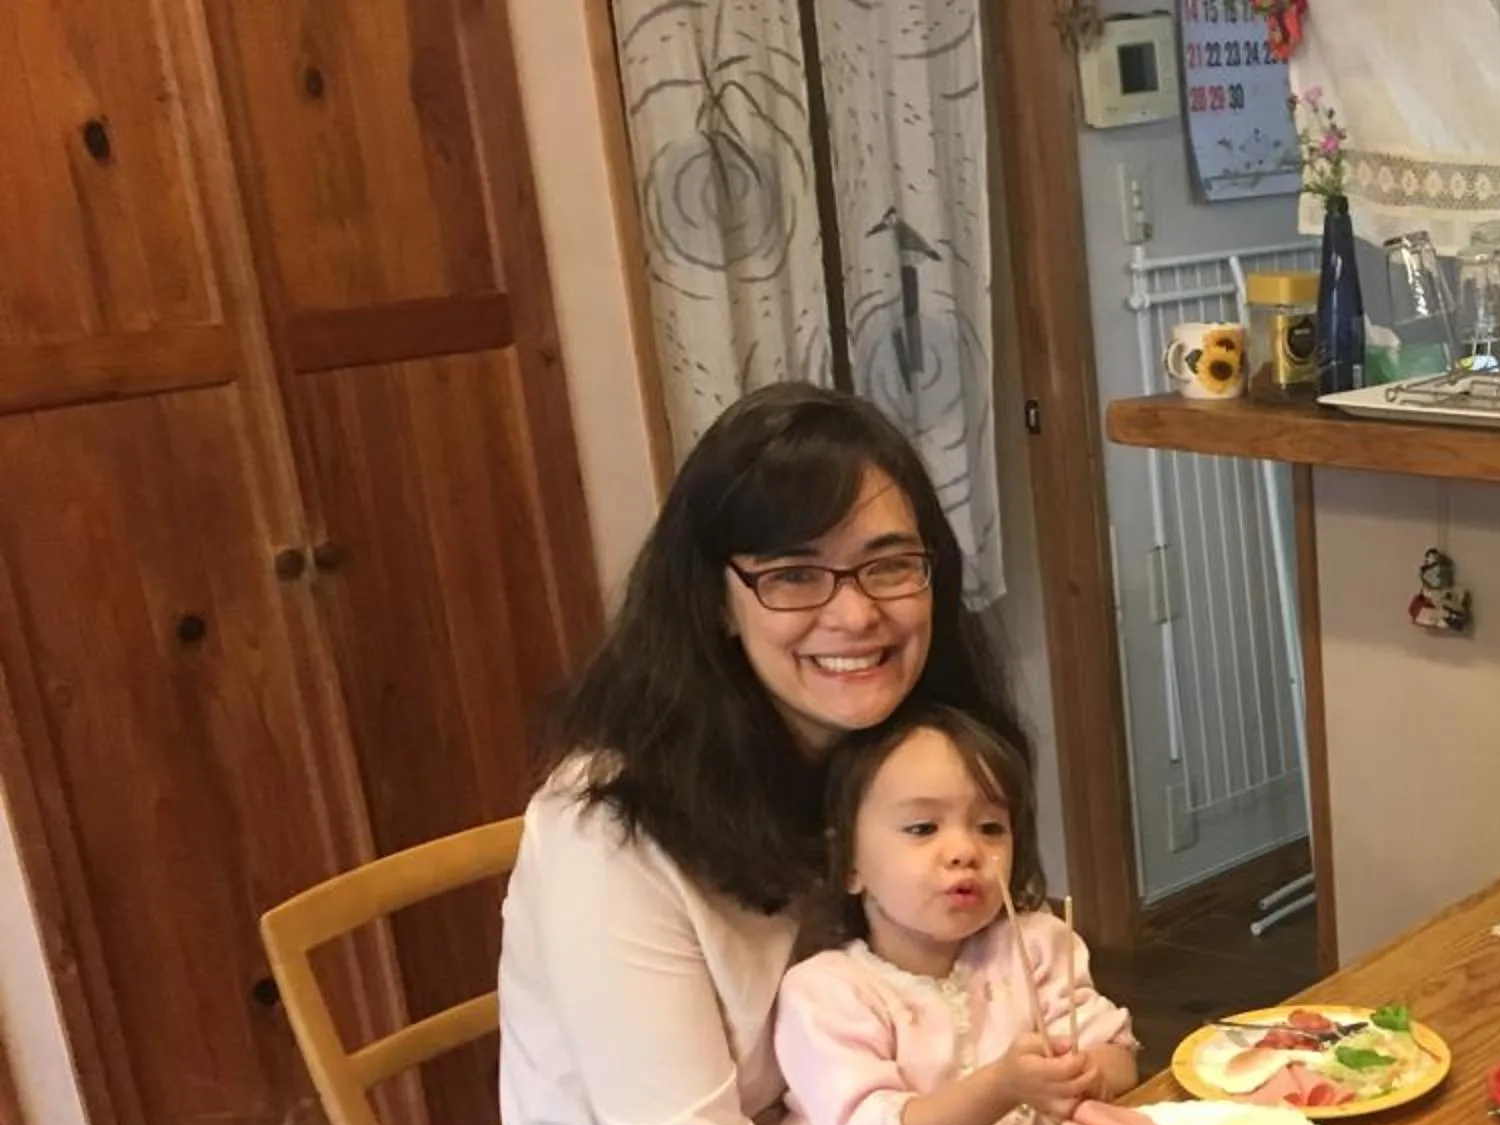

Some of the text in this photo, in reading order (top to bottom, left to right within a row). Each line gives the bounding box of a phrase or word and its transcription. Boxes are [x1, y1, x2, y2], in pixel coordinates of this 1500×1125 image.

[1187, 43, 1203, 68] 21
[1205, 42, 1222, 67] 22
[1224, 41, 1241, 66] 23
[1244, 41, 1261, 66] 24
[1190, 86, 1207, 112] 28
[1228, 83, 1245, 110] 30
